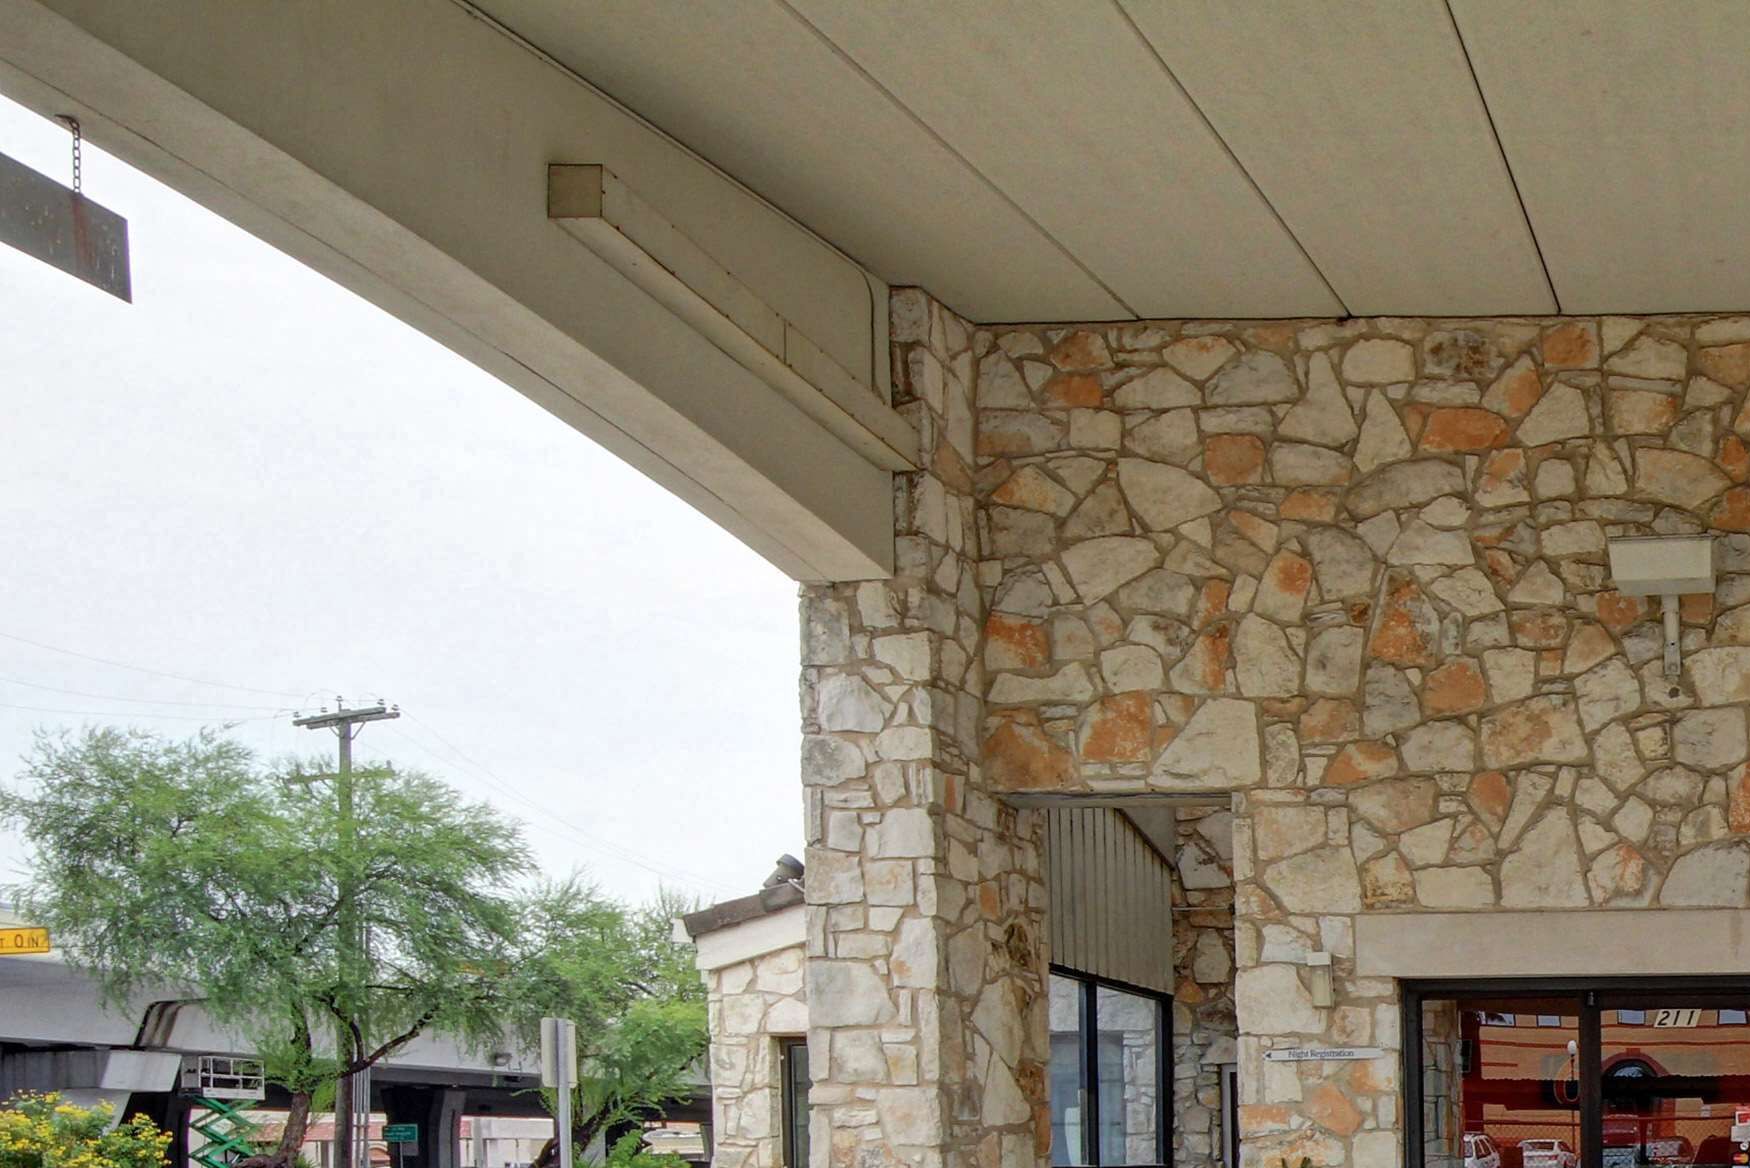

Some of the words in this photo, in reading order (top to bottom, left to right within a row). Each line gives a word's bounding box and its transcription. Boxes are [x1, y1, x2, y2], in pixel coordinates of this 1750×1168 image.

[27, 935, 39, 948] IN
[1657, 1010, 1695, 1026] 211
[1288, 1050, 1309, 1059] Night
[1310, 1048, 1355, 1058] Registration
